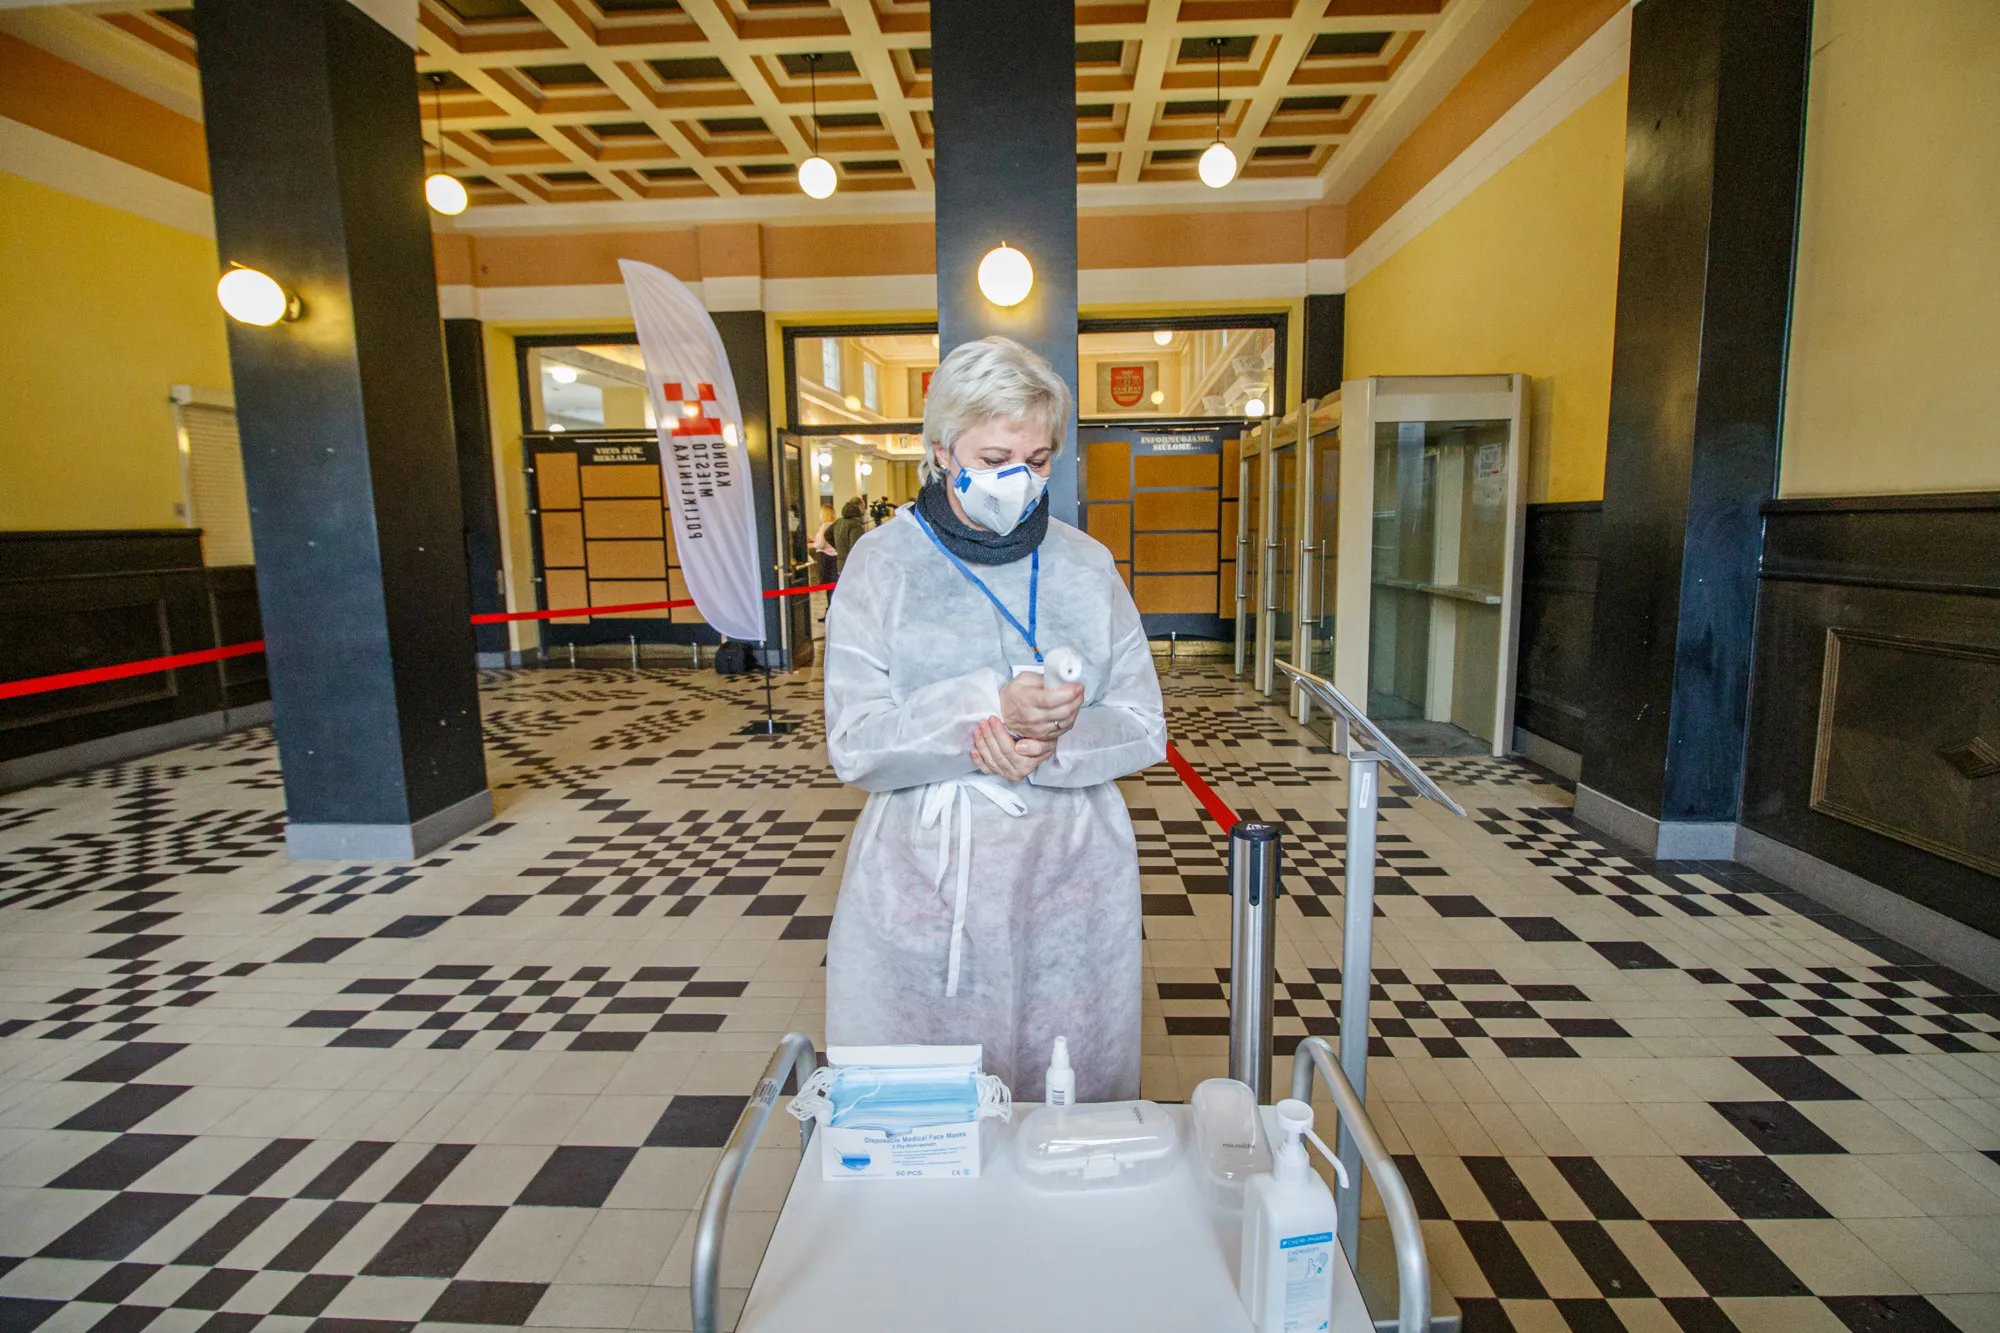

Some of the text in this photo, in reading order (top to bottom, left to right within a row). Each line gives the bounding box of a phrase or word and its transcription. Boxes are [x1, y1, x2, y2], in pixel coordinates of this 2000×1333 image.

[864, 1136, 900, 1145] Disposable
[902, 1134, 927, 1143] Medical
[929, 1133, 945, 1141] Face
